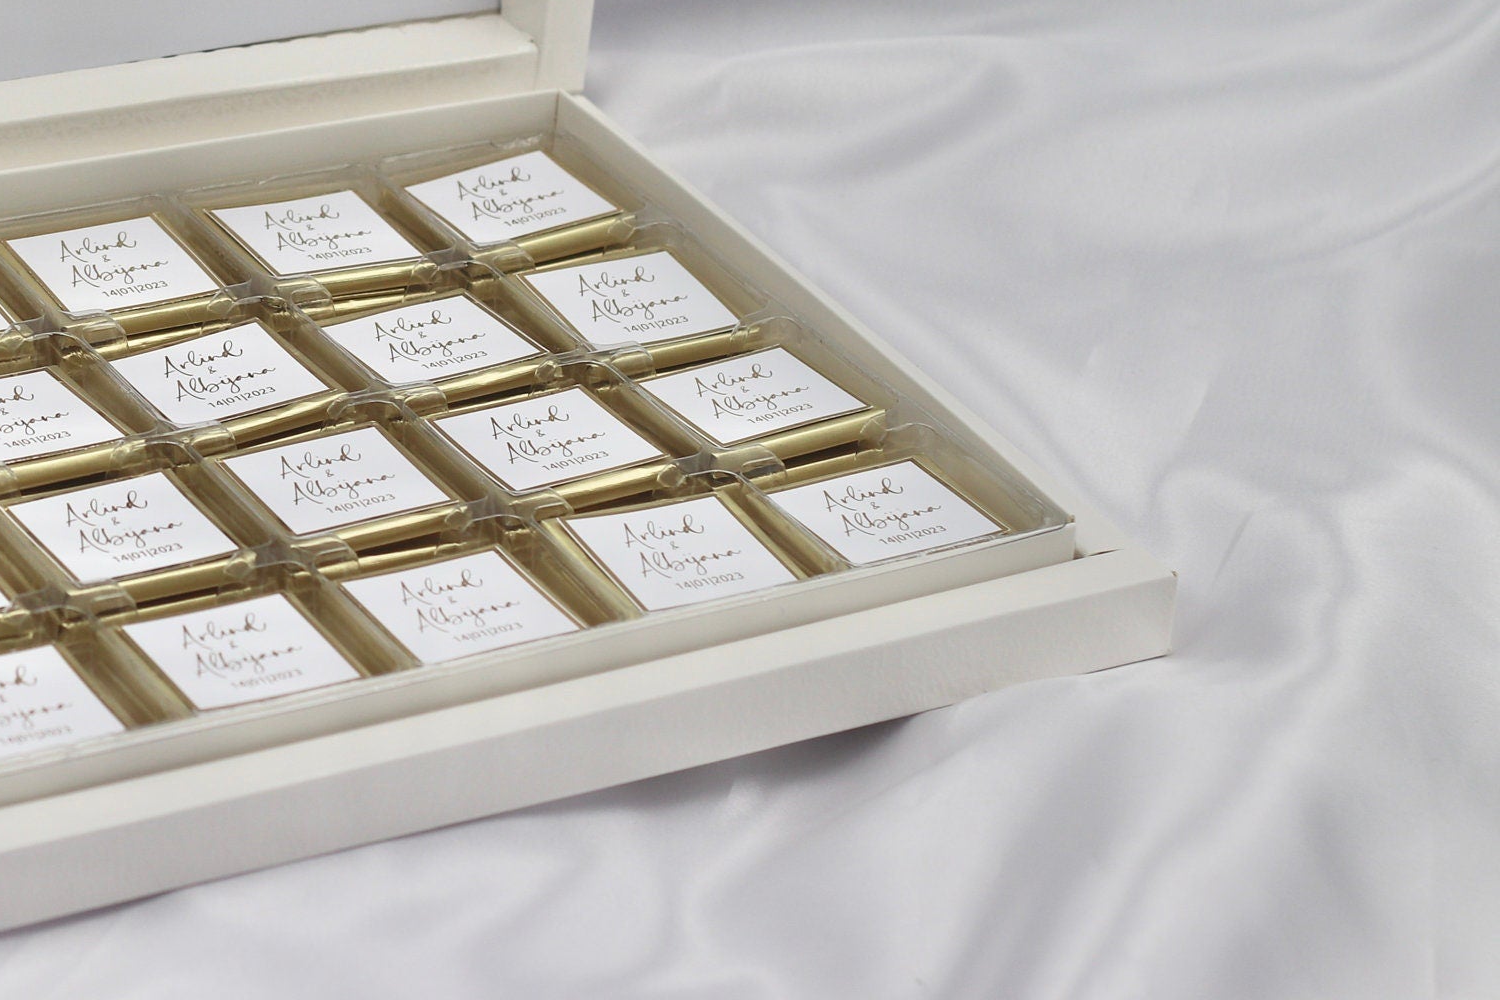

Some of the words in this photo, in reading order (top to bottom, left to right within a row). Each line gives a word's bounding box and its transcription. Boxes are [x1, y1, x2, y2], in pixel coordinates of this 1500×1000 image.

[457, 166, 532, 201] Arlind
[265, 204, 341, 232] Arlind
[471, 189, 566, 222] Albijana
[60, 230, 138, 264] Arlind
[277, 231, 373, 252] Albijana
[71, 261, 170, 288] Albijana
[579, 264, 655, 299] Arlind
[375, 309, 452, 342] Arlind
[592, 296, 690, 324] Albijana
[164, 339, 244, 379] Arlind
[388, 333, 488, 364] Albijana
[177, 366, 278, 403] Albijana
[695, 363, 773, 398] Arlind
[711, 386, 810, 419] Albijana
[490, 405, 570, 441] Arlind
[280, 444, 362, 480] Arlind
[506, 432, 607, 465] Albijana
[293, 473, 397, 506] Albijana
[822, 477, 904, 513] Arlind
[66, 490, 149, 528] Arlind
[841, 506, 942, 538] Albijana
[79, 522, 185, 554] Albijana
[623, 514, 705, 551] Arlind
[639, 550, 742, 579] Albijana
[400, 569, 483, 607] Arlind
[416, 600, 521, 634] Albijana
